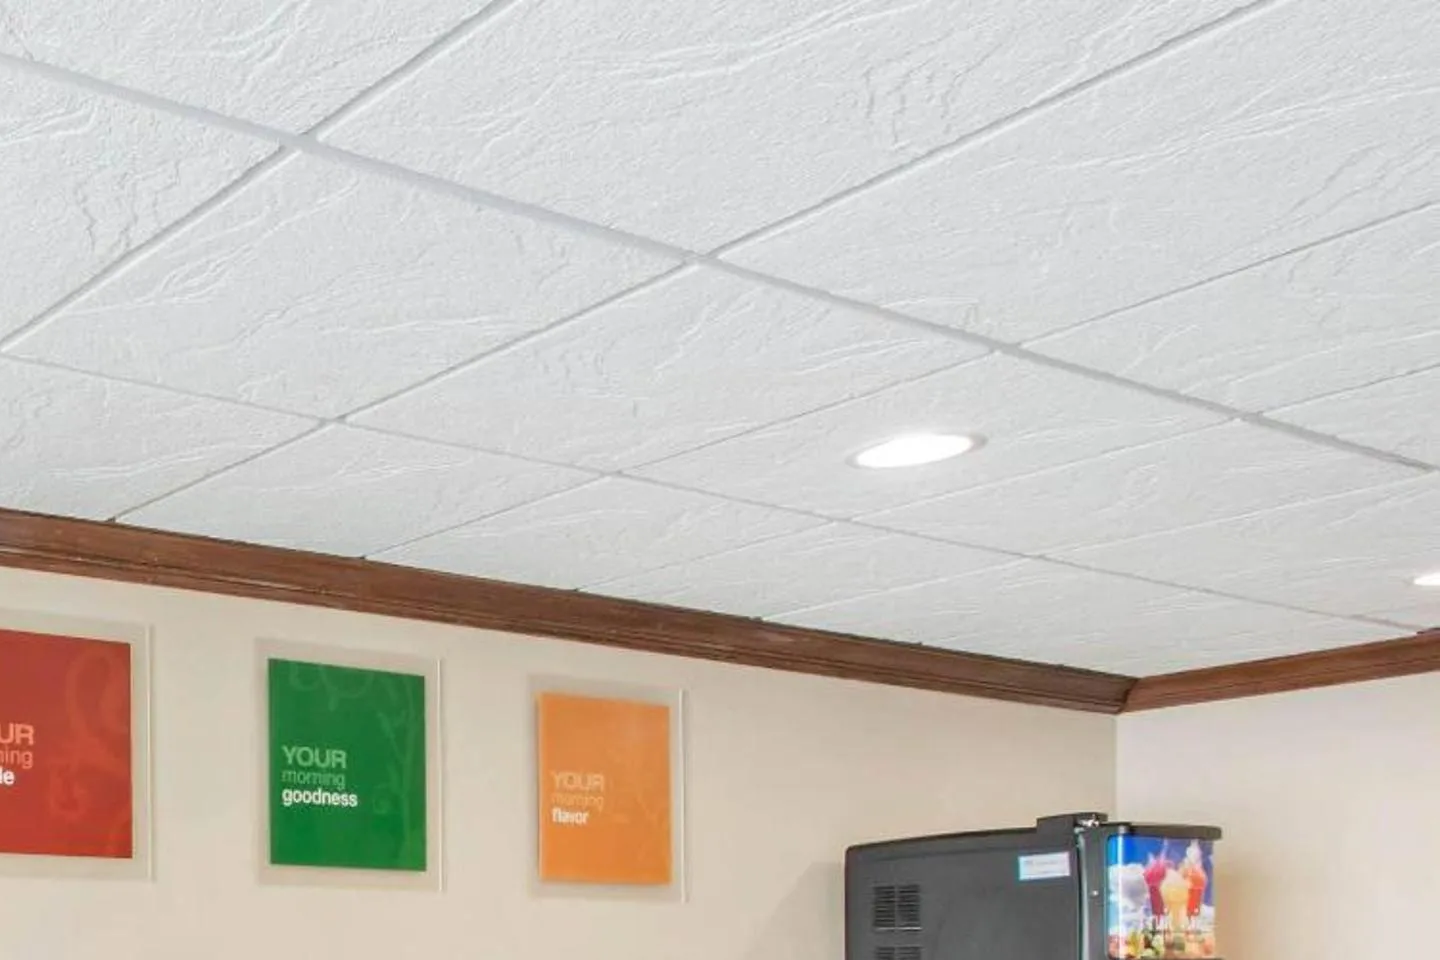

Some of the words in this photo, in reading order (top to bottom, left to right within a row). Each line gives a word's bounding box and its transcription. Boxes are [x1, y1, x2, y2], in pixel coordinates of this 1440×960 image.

[281, 745, 347, 769] YOUR
[281, 769, 346, 791] morning
[552, 771, 605, 792] YOUR
[282, 788, 358, 807] goodness
[552, 807, 589, 825] flavor
